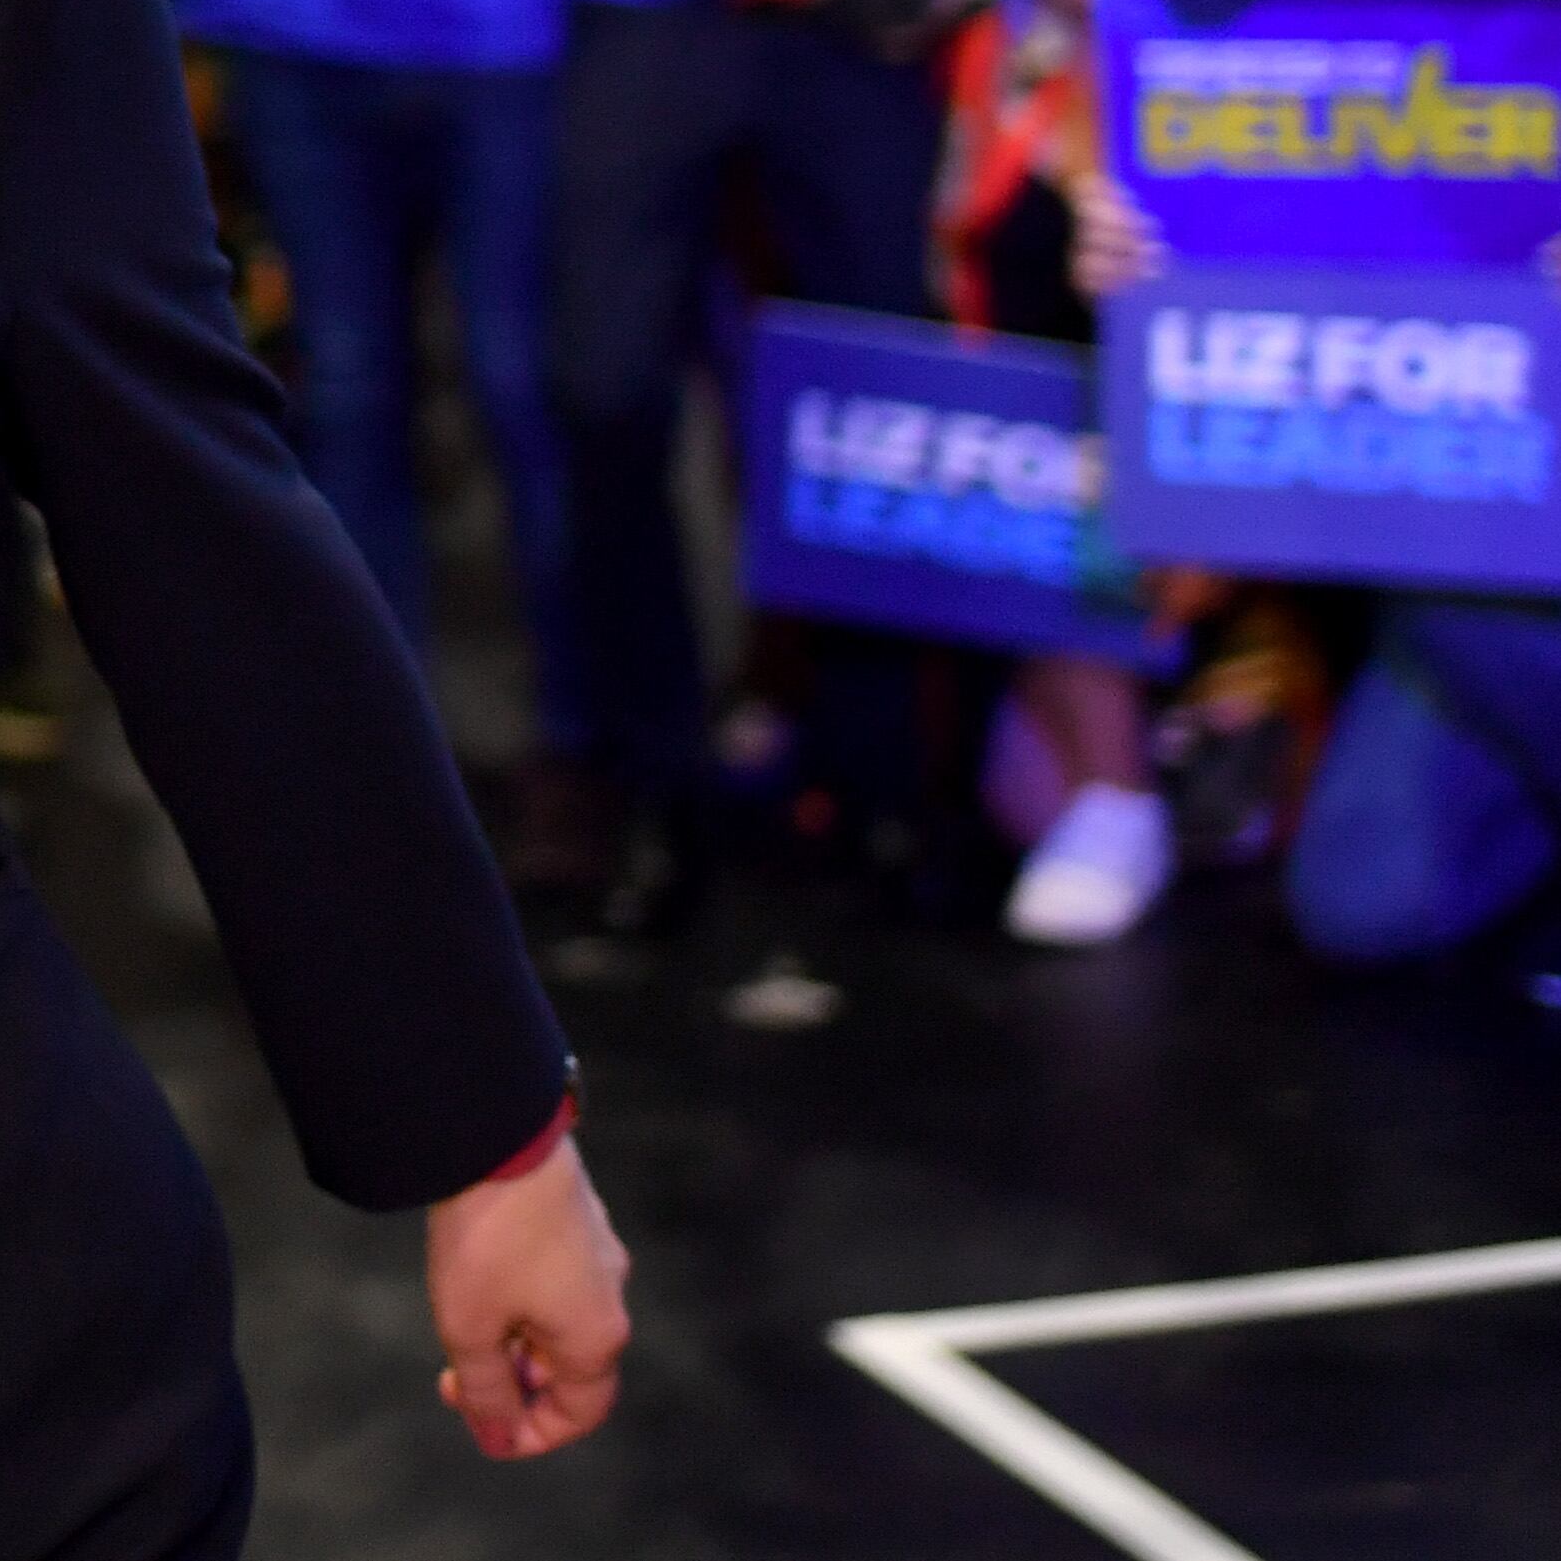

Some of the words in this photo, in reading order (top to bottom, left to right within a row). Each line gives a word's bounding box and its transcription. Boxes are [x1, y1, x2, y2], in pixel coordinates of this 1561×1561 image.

[1141, 50, 1561, 180] DELIVER
[1147, 306, 1307, 405] LIZ
[1312, 313, 1533, 418] FOR
[789, 390, 929, 487] LIZ
[1147, 398, 1553, 502] LEADER
[785, 474, 1094, 588] LEADE
